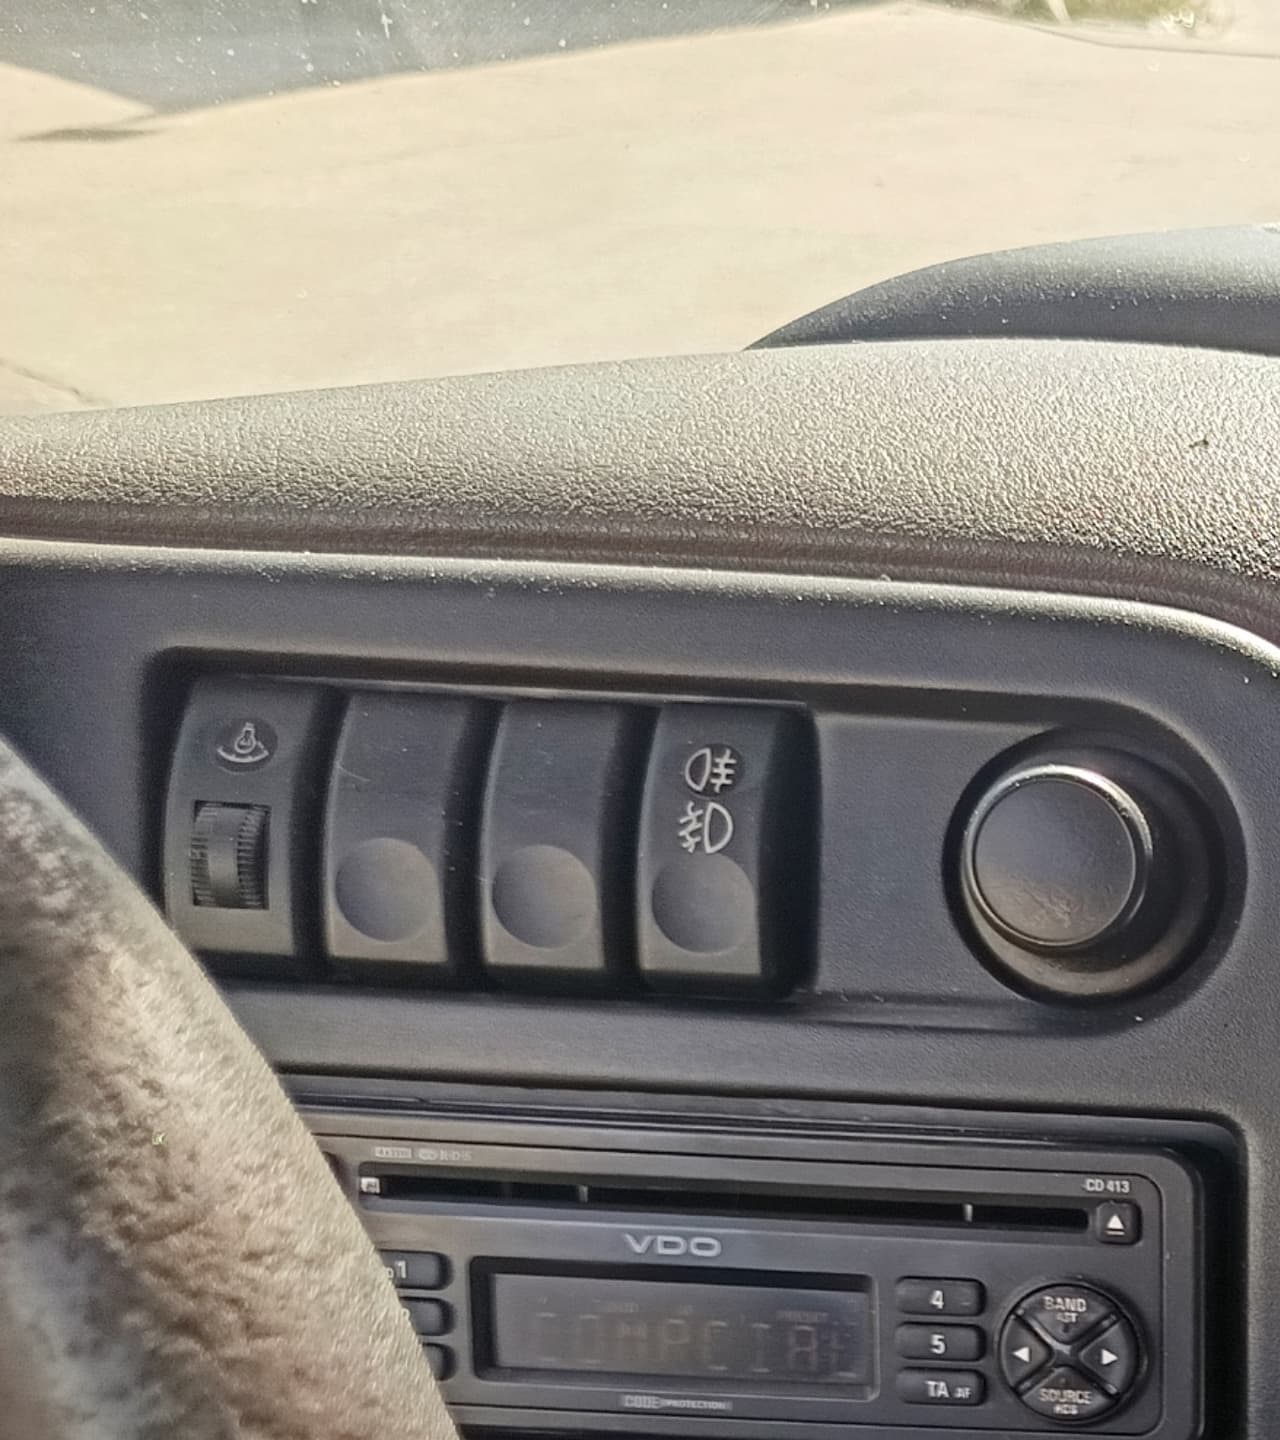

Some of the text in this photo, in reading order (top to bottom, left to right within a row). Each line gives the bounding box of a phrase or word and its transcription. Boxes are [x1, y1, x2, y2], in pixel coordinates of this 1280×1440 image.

[1084, 1179, 1130, 1193] CD 413
[623, 1233, 723, 1257] VDO
[929, 1290, 945, 1310] 4
[1041, 1295, 1087, 1312] BAND
[929, 1334, 946, 1354] 5
[924, 1381, 949, 1398] TA
[1038, 1388, 1092, 1405] SOURCE
[623, 1394, 662, 1411] CODE
